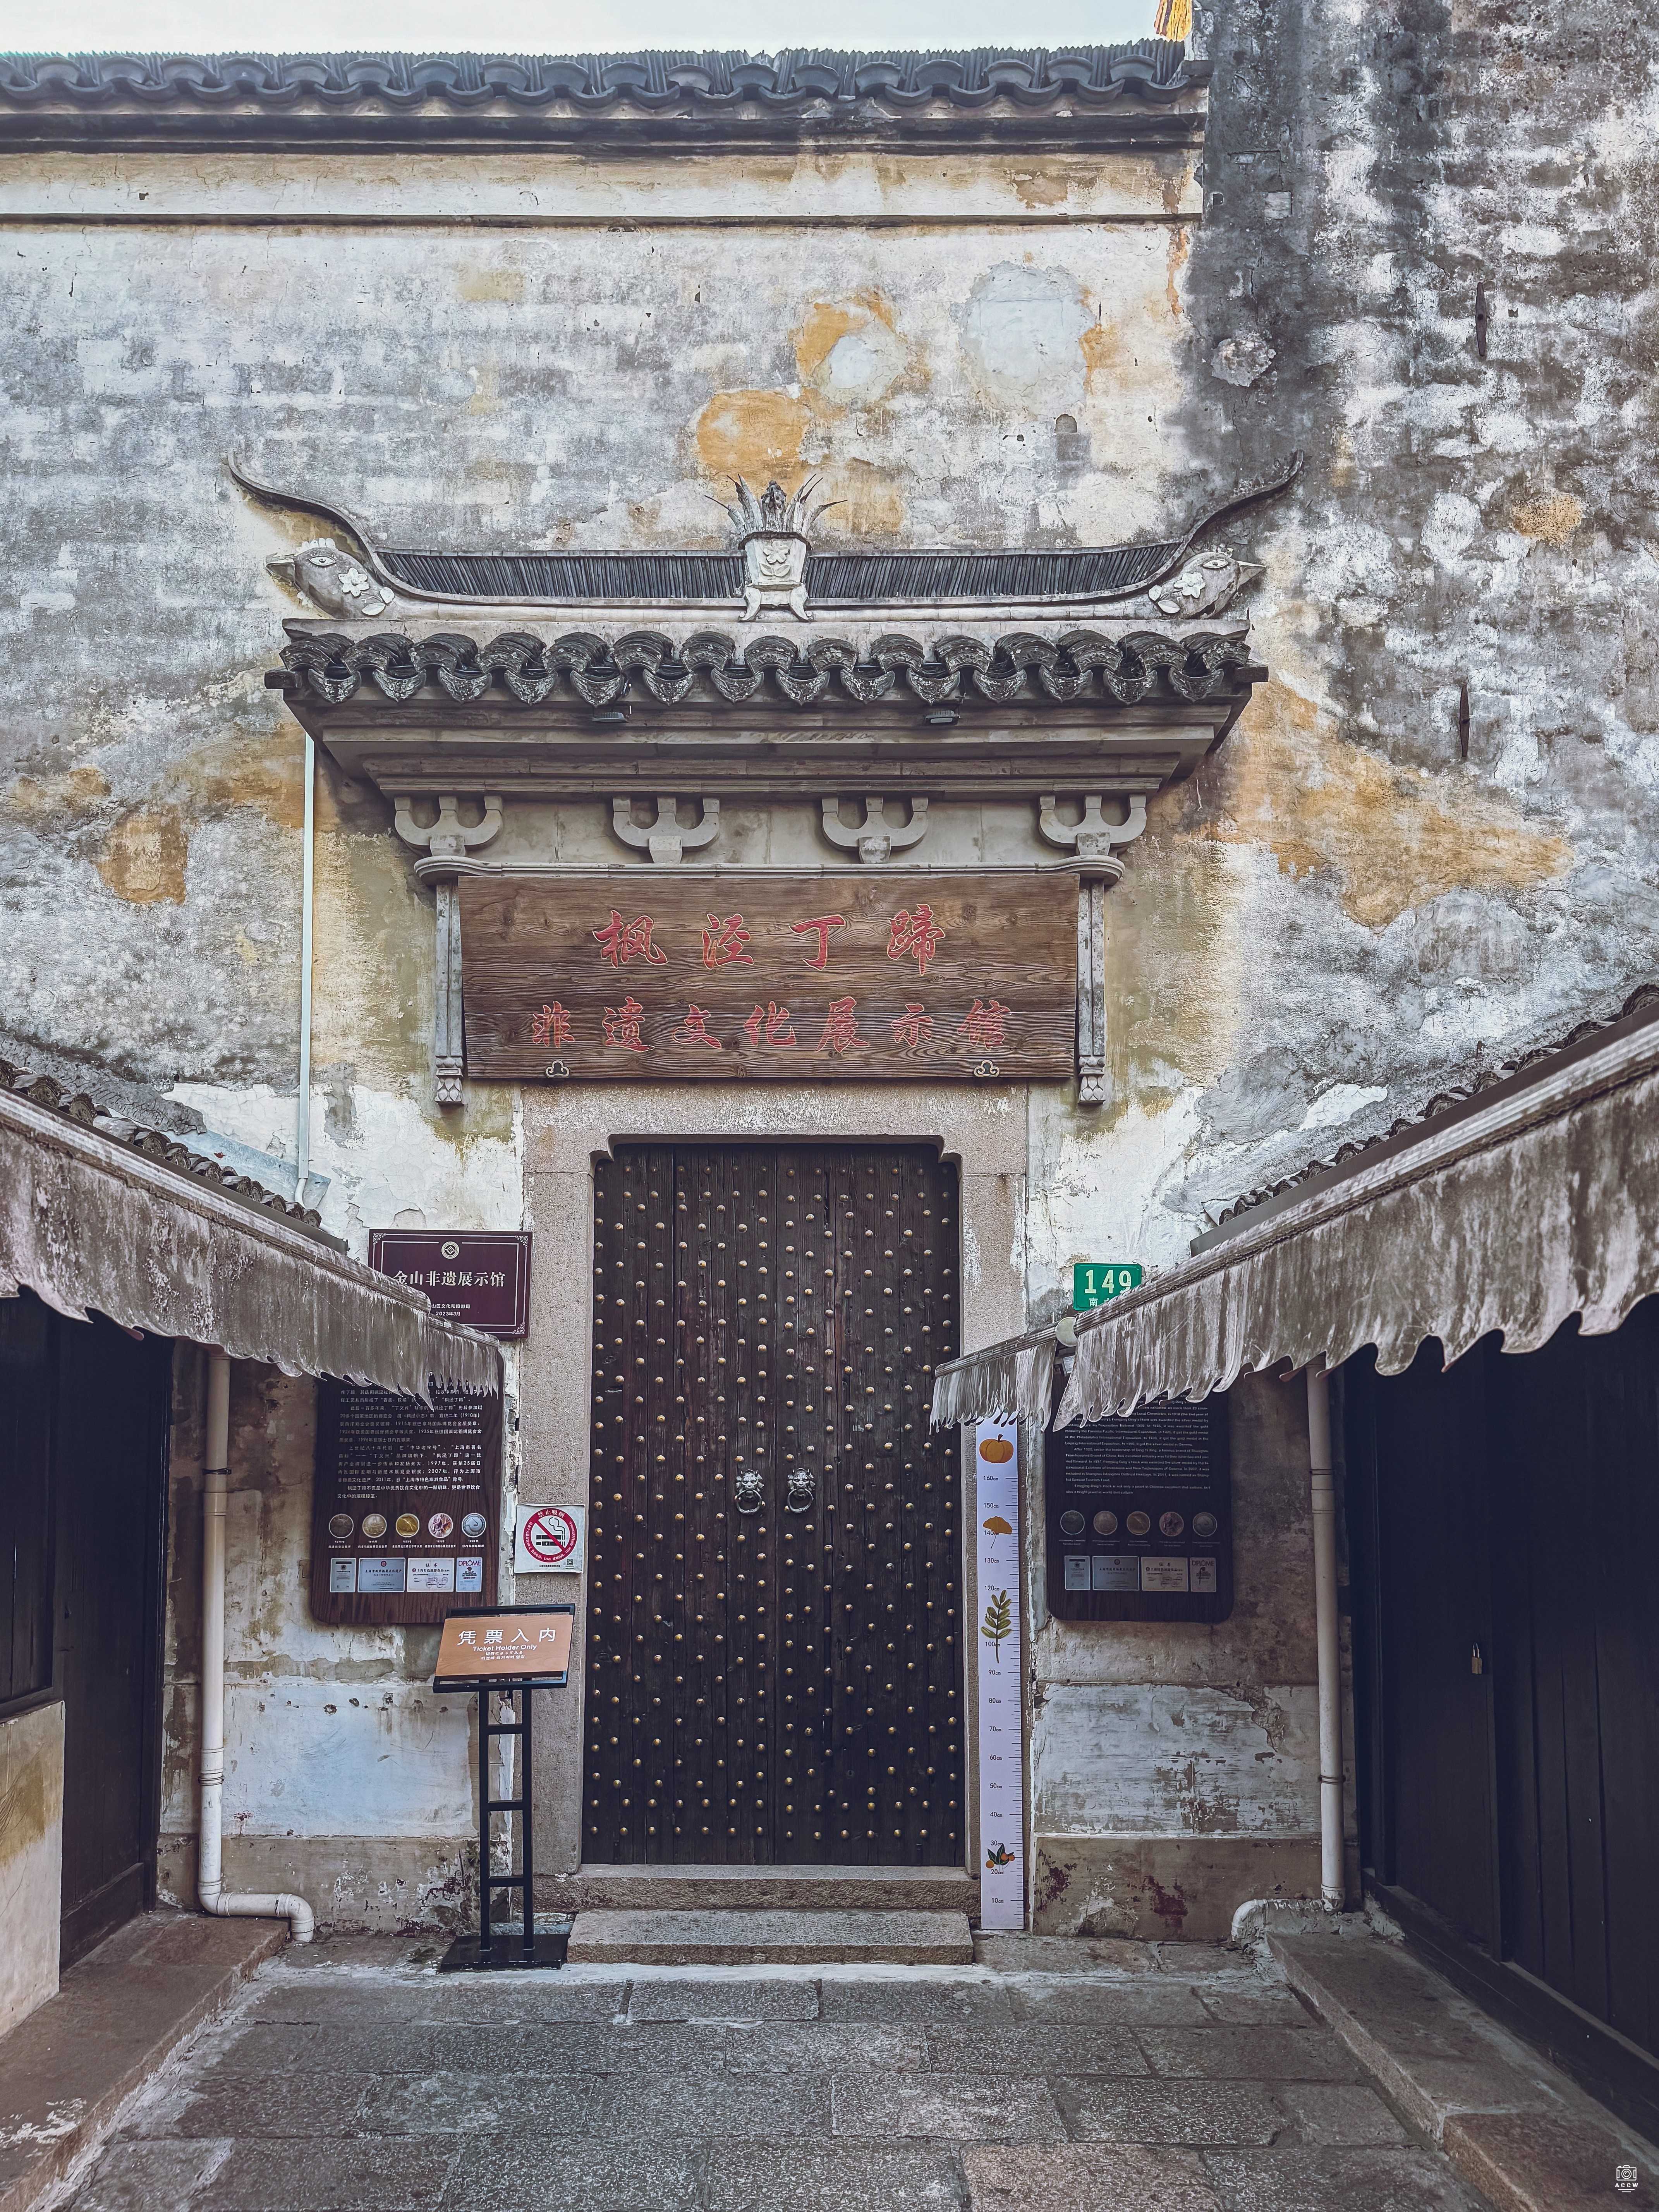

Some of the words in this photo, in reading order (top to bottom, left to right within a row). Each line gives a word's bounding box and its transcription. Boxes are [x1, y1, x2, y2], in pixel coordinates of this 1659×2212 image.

[592, 903, 945, 974] 枫泾丁蹄
[532, 995, 1012, 1053] 非遗文化展示馆
[393, 1271, 505, 1287] 金山非遗展示馆
[1085, 1269, 1132, 1294] 149
[457, 1627, 556, 1645] 凭票入内
